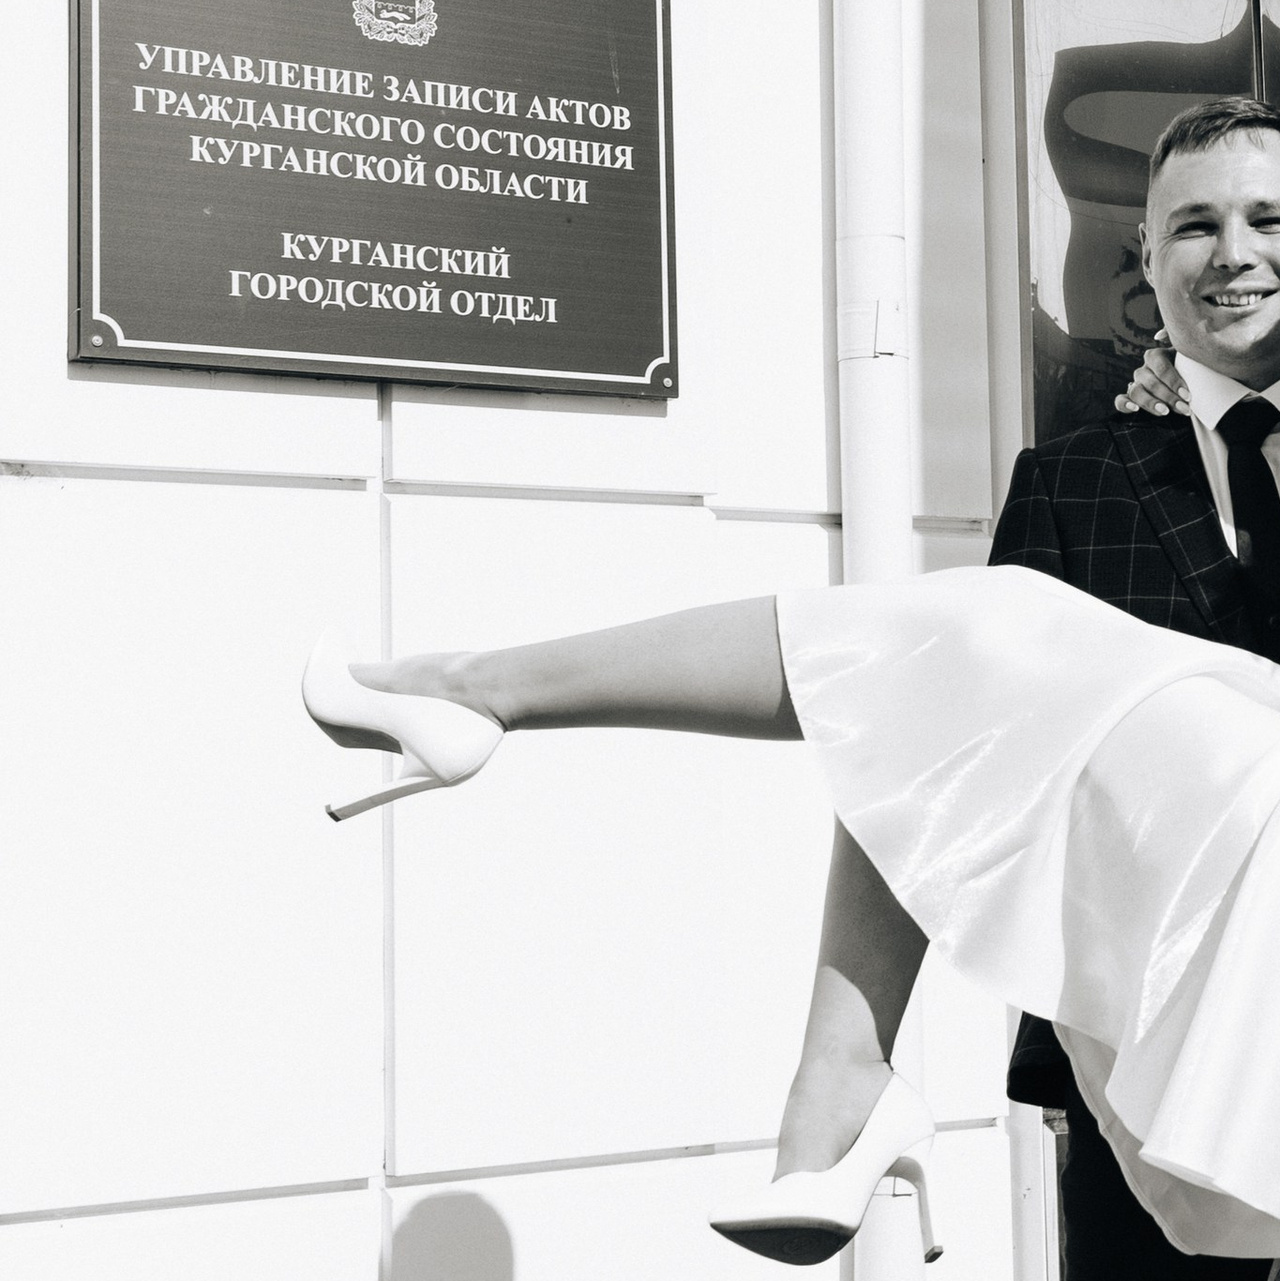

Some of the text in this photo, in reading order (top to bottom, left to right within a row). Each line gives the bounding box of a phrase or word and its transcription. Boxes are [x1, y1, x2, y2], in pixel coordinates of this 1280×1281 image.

[134, 42, 631, 131] УПРАВЛЕНИЕ ЗАПИСИ АКТОВ
[132, 84, 635, 171] ГРАЖДАНСКОГО СОСТОЯНИЯ
[188, 134, 589, 205] КУРГАНСКОЙ ОБЛАСТИ
[280, 231, 511, 279] КУРГАНСКИЙ
[228, 269, 558, 325] ГОРОДСКОЙ ОТДЕЛ
